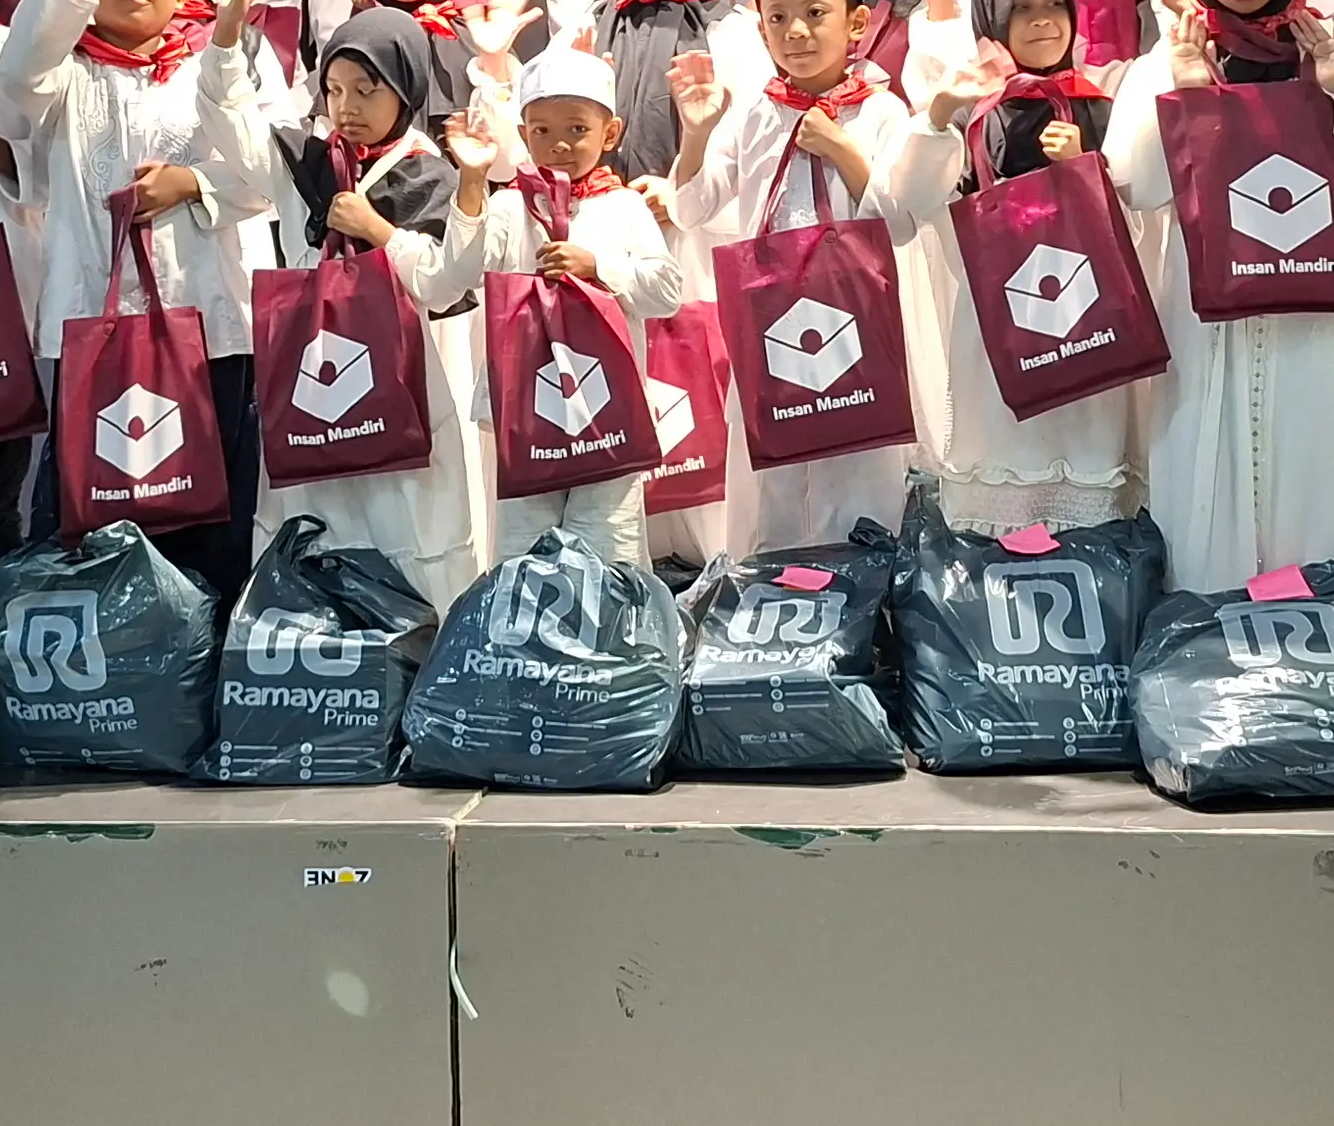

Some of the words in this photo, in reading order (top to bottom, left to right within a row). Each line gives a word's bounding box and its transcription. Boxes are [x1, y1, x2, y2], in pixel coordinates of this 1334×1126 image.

[1230, 259, 1276, 276] Insan
[1019, 351, 1058, 373] Insan
[1061, 327, 1117, 362] Mandiri
[772, 402, 812, 421] Insan
[814, 388, 876, 414] Mandiri
[287, 430, 326, 447] Insan
[328, 418, 386, 444] Mandiri
[530, 443, 568, 460] Insan
[571, 429, 627, 456] Mandiri
[653, 455, 706, 479] Mandiri
[91, 485, 131, 502] Insan
[133, 476, 194, 501] Mandiri
[464, 649, 614, 685] Ramayana
[977, 660, 1130, 688] Ramayana
[223, 681, 380, 711] Ramayana
[554, 683, 612, 703] Prime
[1080, 683, 1129, 701] Prim
[5, 696, 136, 730] Ramayana
[88, 716, 139, 734] Prime
[323, 709, 379, 727] Prime
